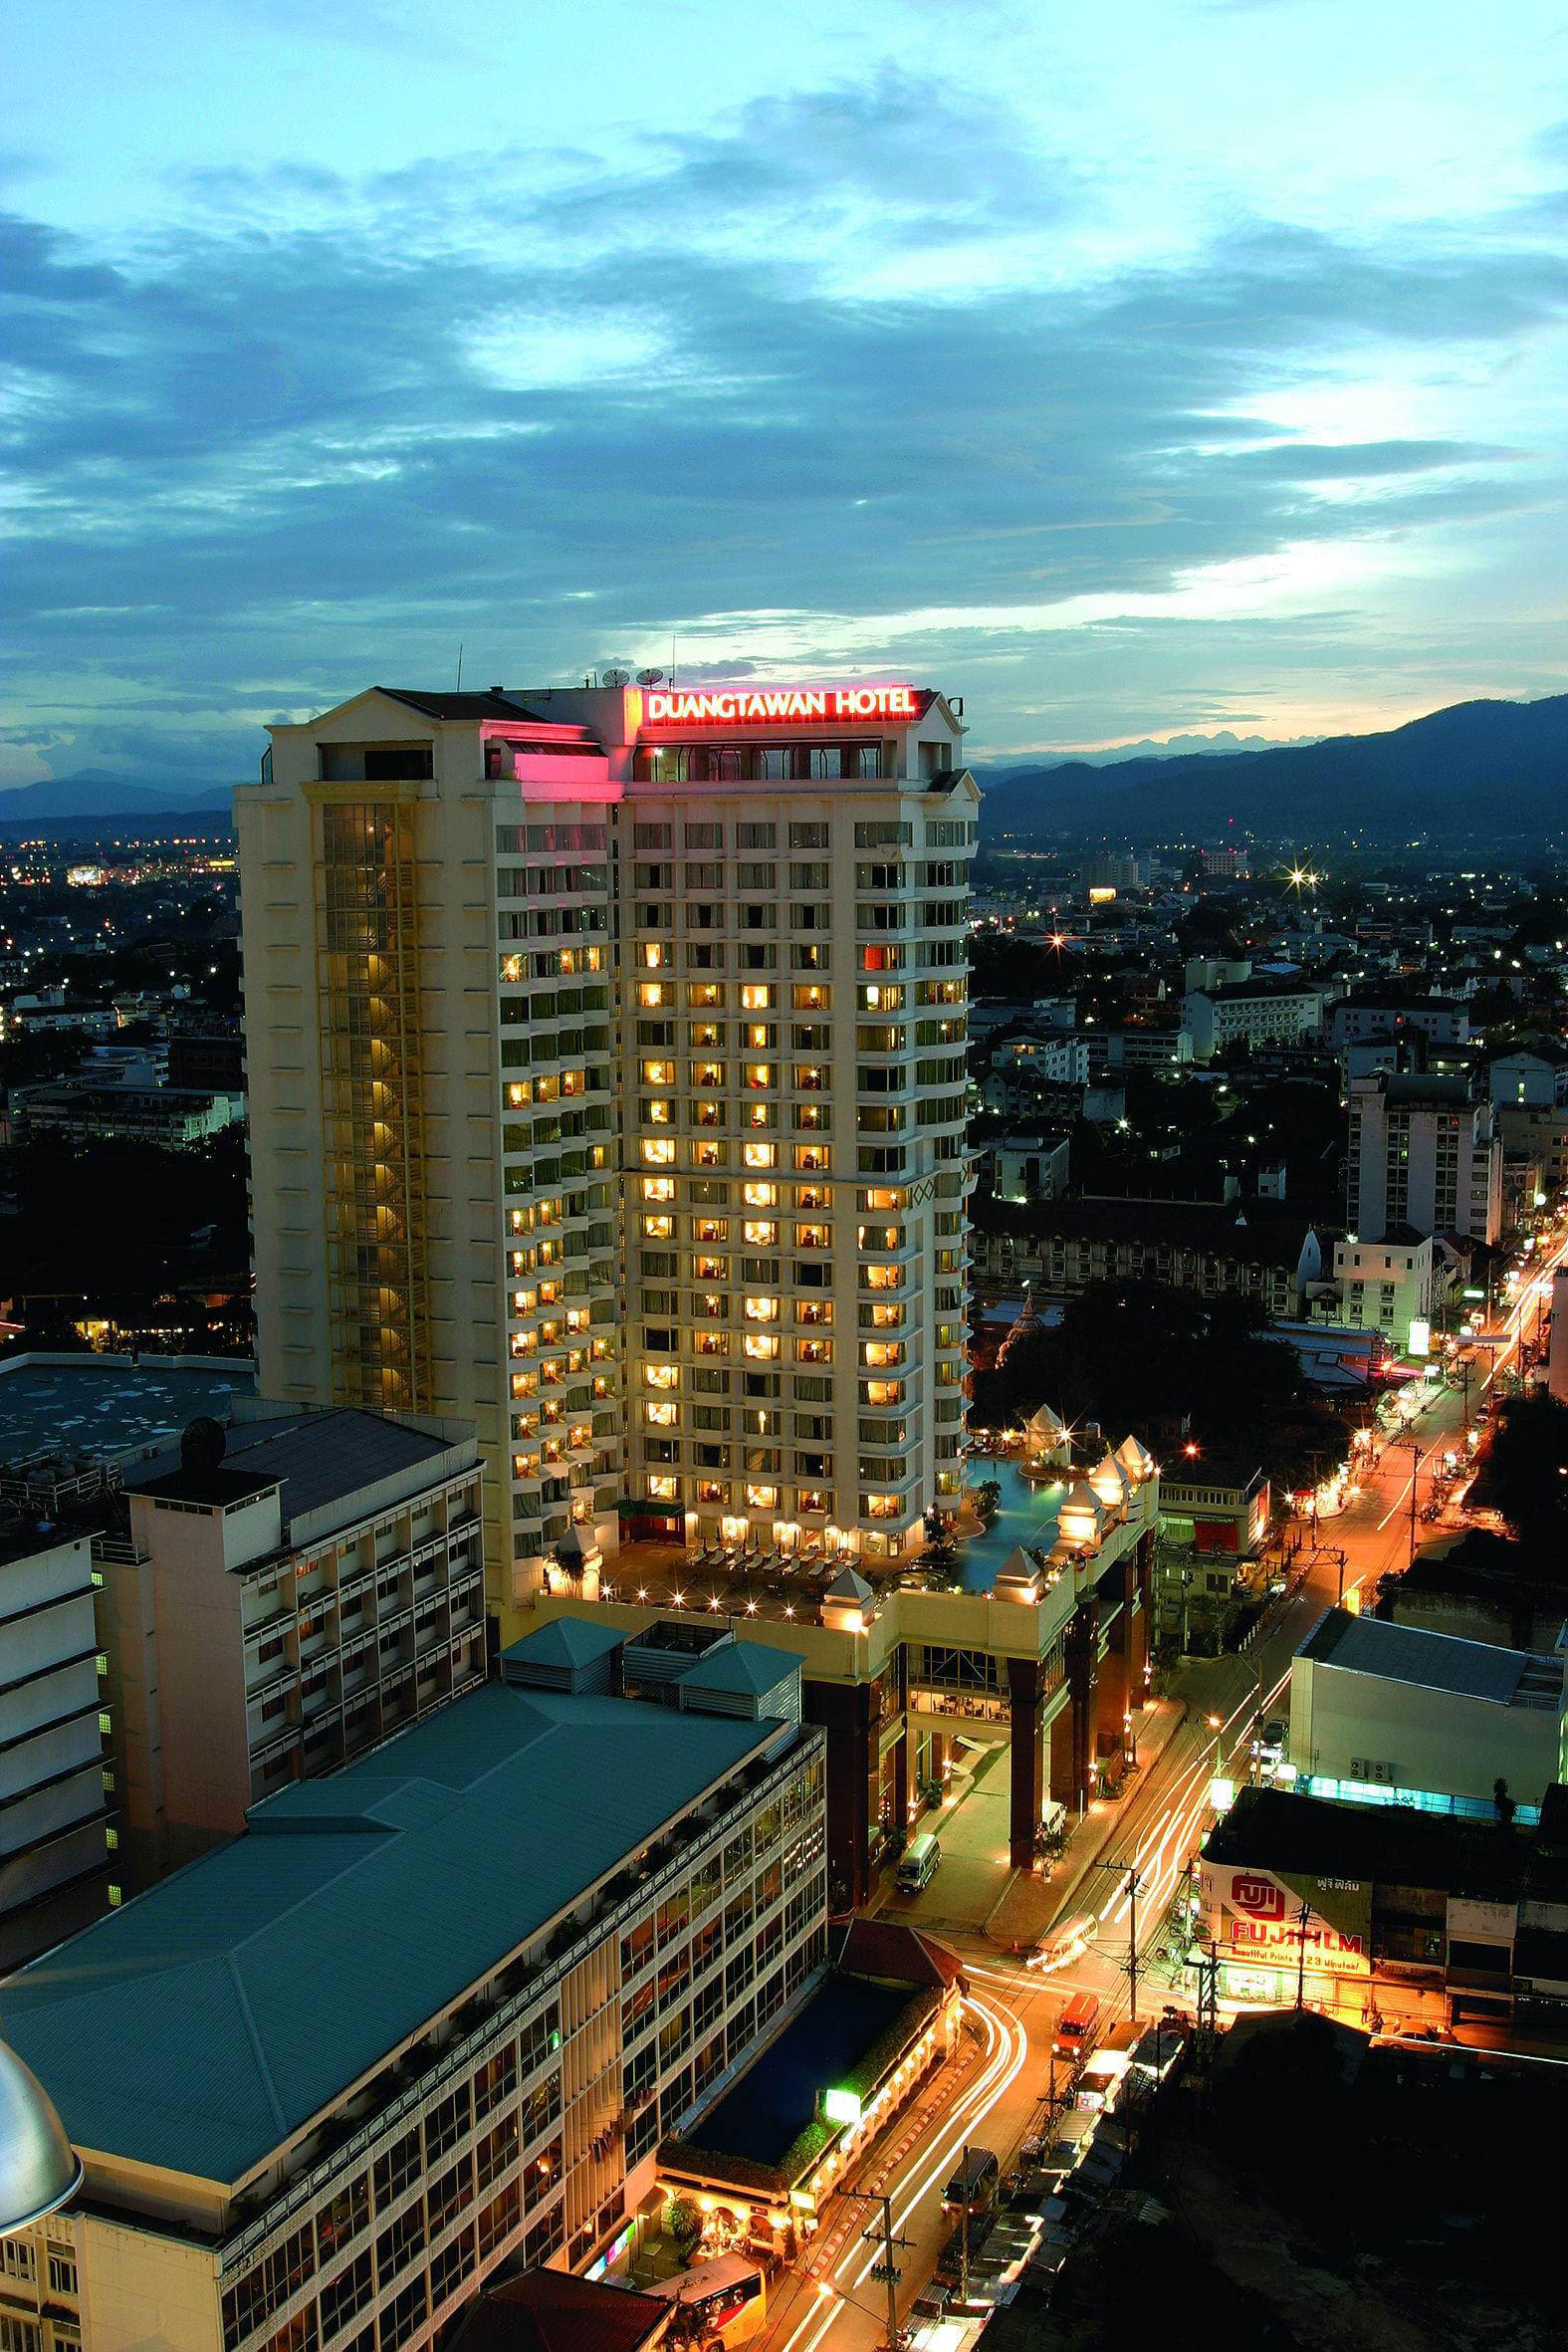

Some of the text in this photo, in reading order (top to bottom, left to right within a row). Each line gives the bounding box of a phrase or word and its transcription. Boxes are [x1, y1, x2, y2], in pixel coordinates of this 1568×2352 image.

[649, 690, 825, 719] DUANGTAWAN
[836, 688, 915, 713] HOTEL
[1232, 1875, 1284, 1917] FUJI
[1231, 1920, 1362, 1954] FUJIFILM
